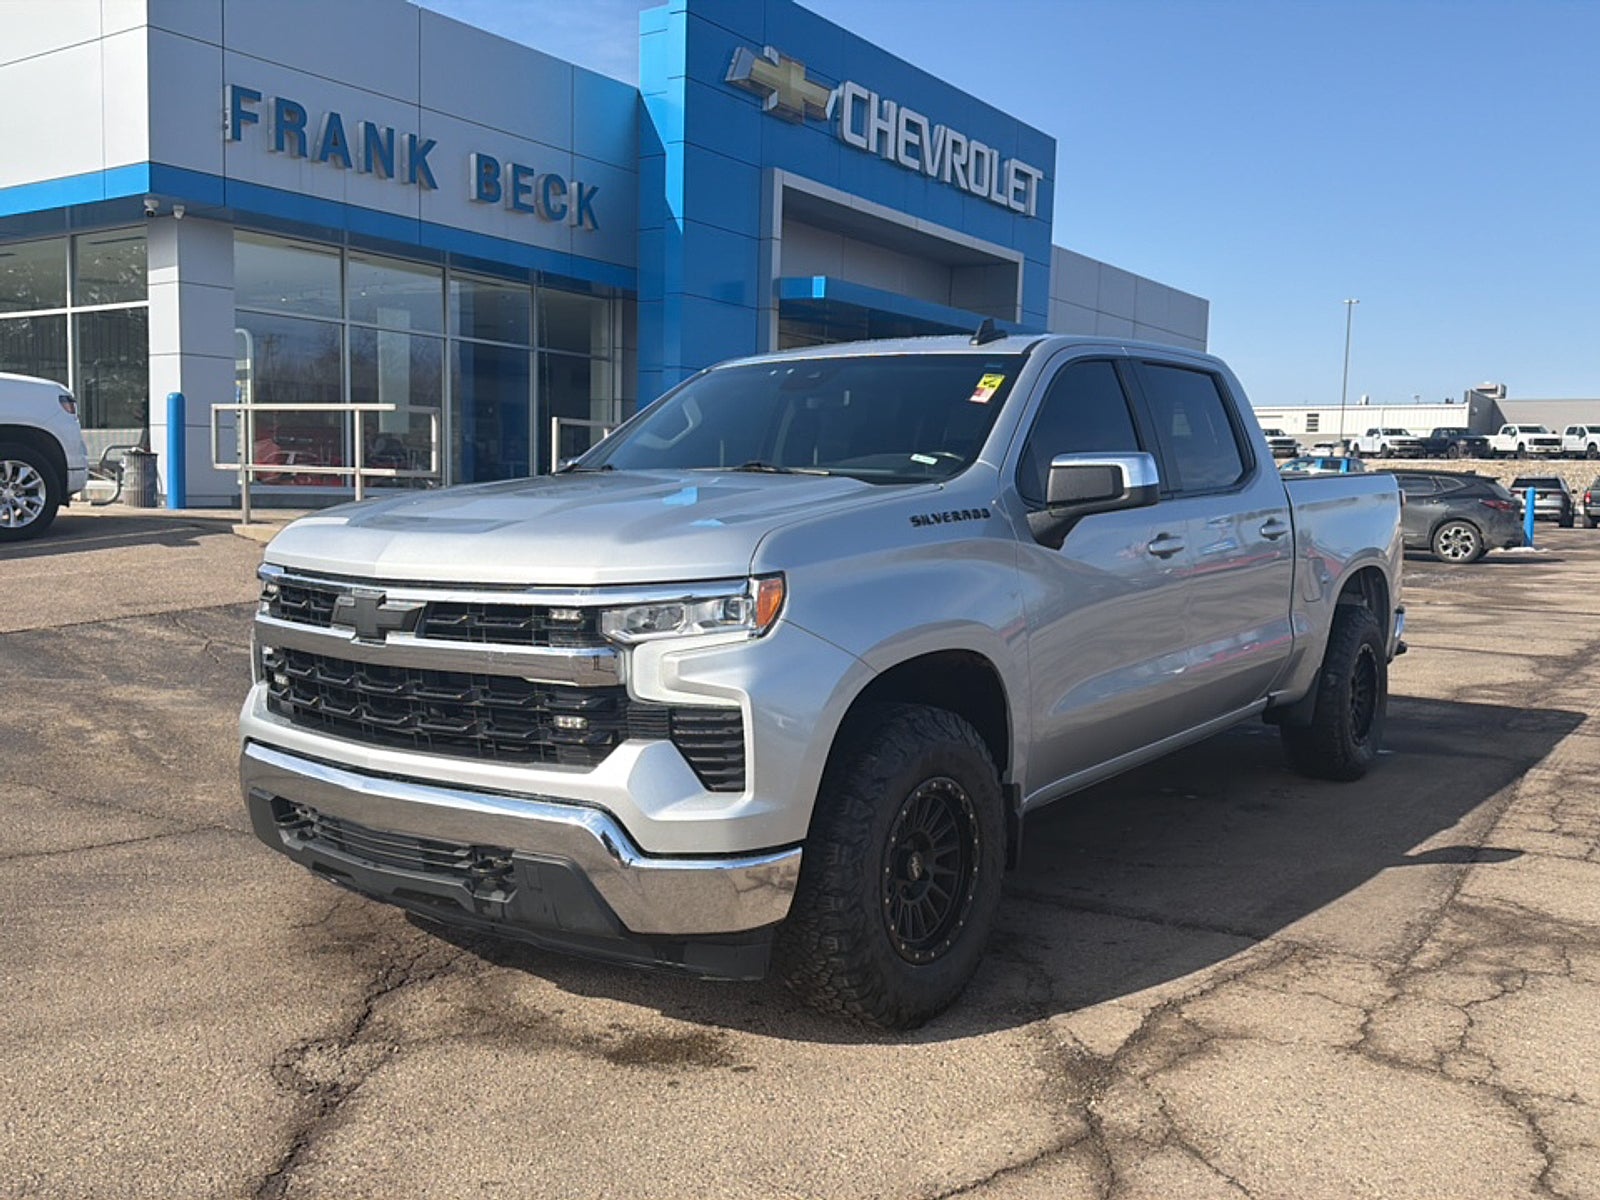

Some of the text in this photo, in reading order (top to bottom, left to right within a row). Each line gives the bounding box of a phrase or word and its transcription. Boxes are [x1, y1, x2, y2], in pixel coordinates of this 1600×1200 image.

[224, 84, 600, 230] FRANK BECK
[841, 81, 1043, 216] CHEVROLET
[910, 508, 991, 527] SILVERADO
